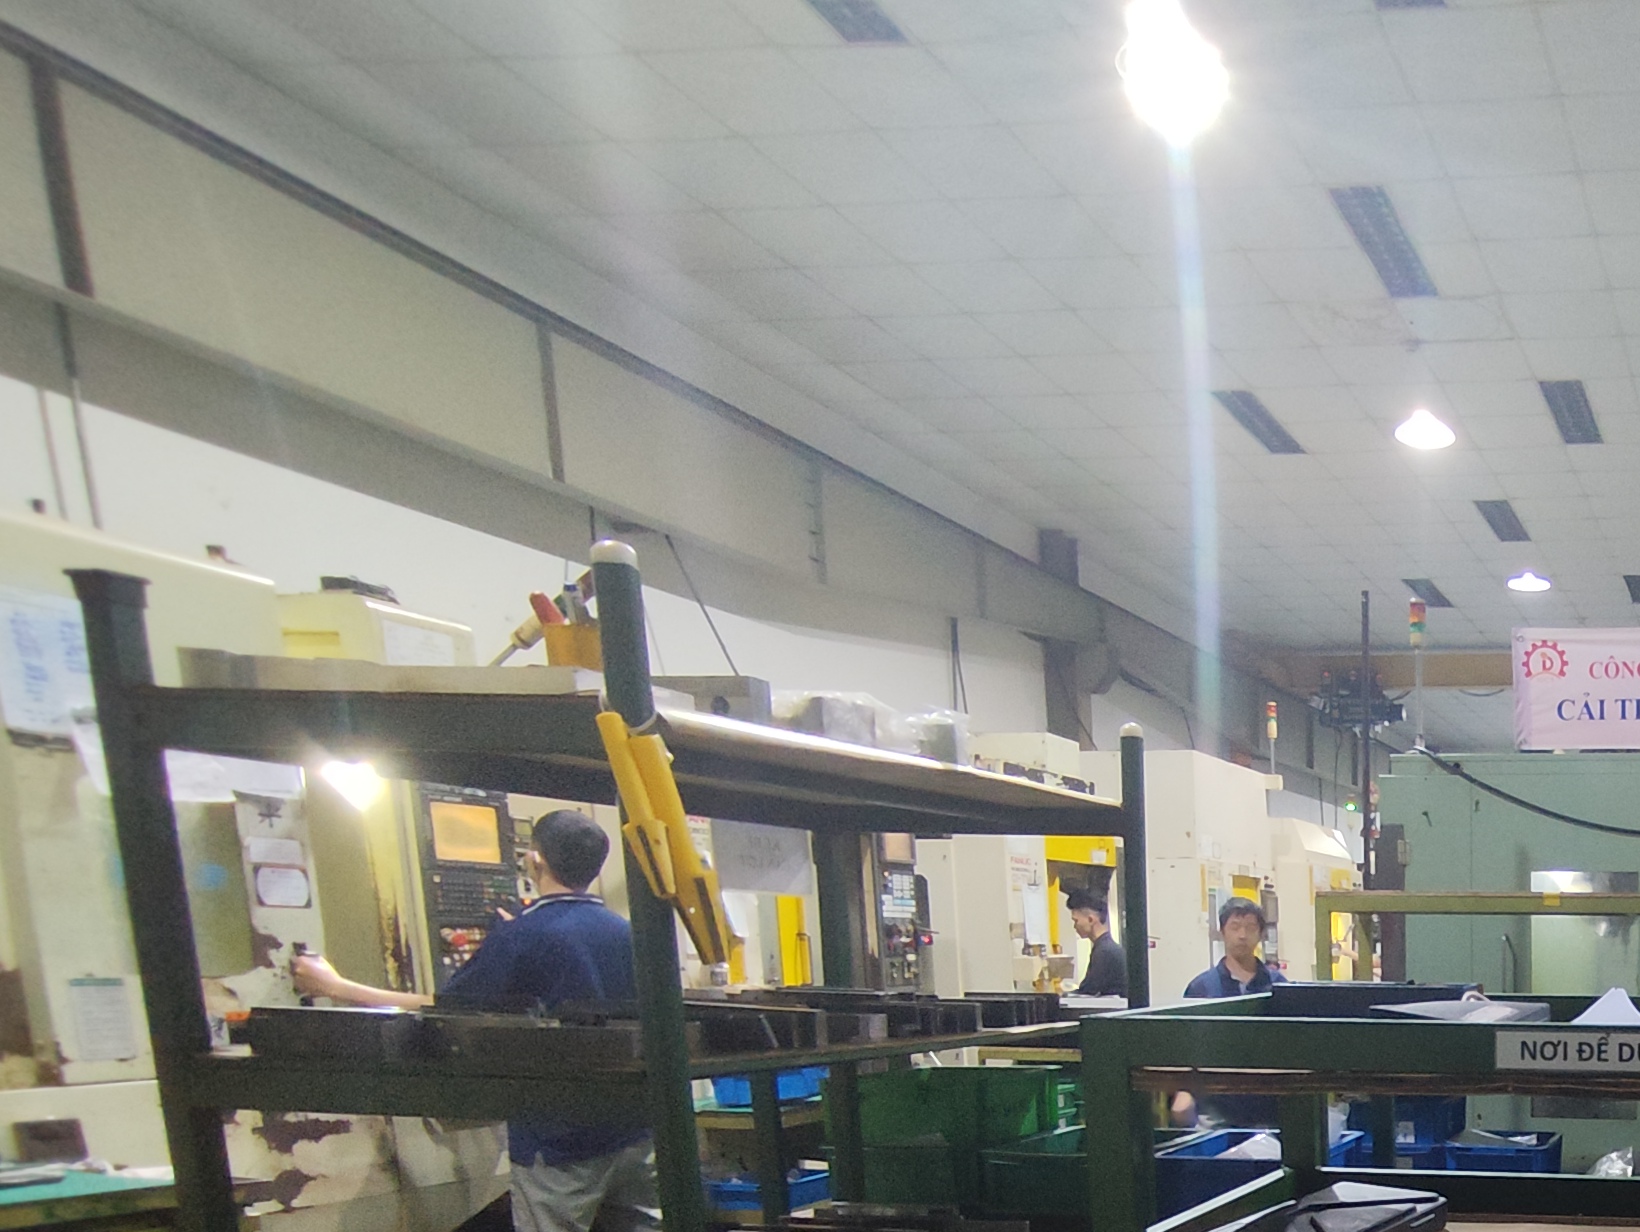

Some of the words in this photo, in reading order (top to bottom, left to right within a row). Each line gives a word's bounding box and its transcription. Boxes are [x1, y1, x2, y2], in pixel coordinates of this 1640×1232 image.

[1557, 692, 1605, 721] CẢI
[1520, 1040, 1568, 1062] NƠI
[1576, 1032, 1610, 1063] ĐỂ
